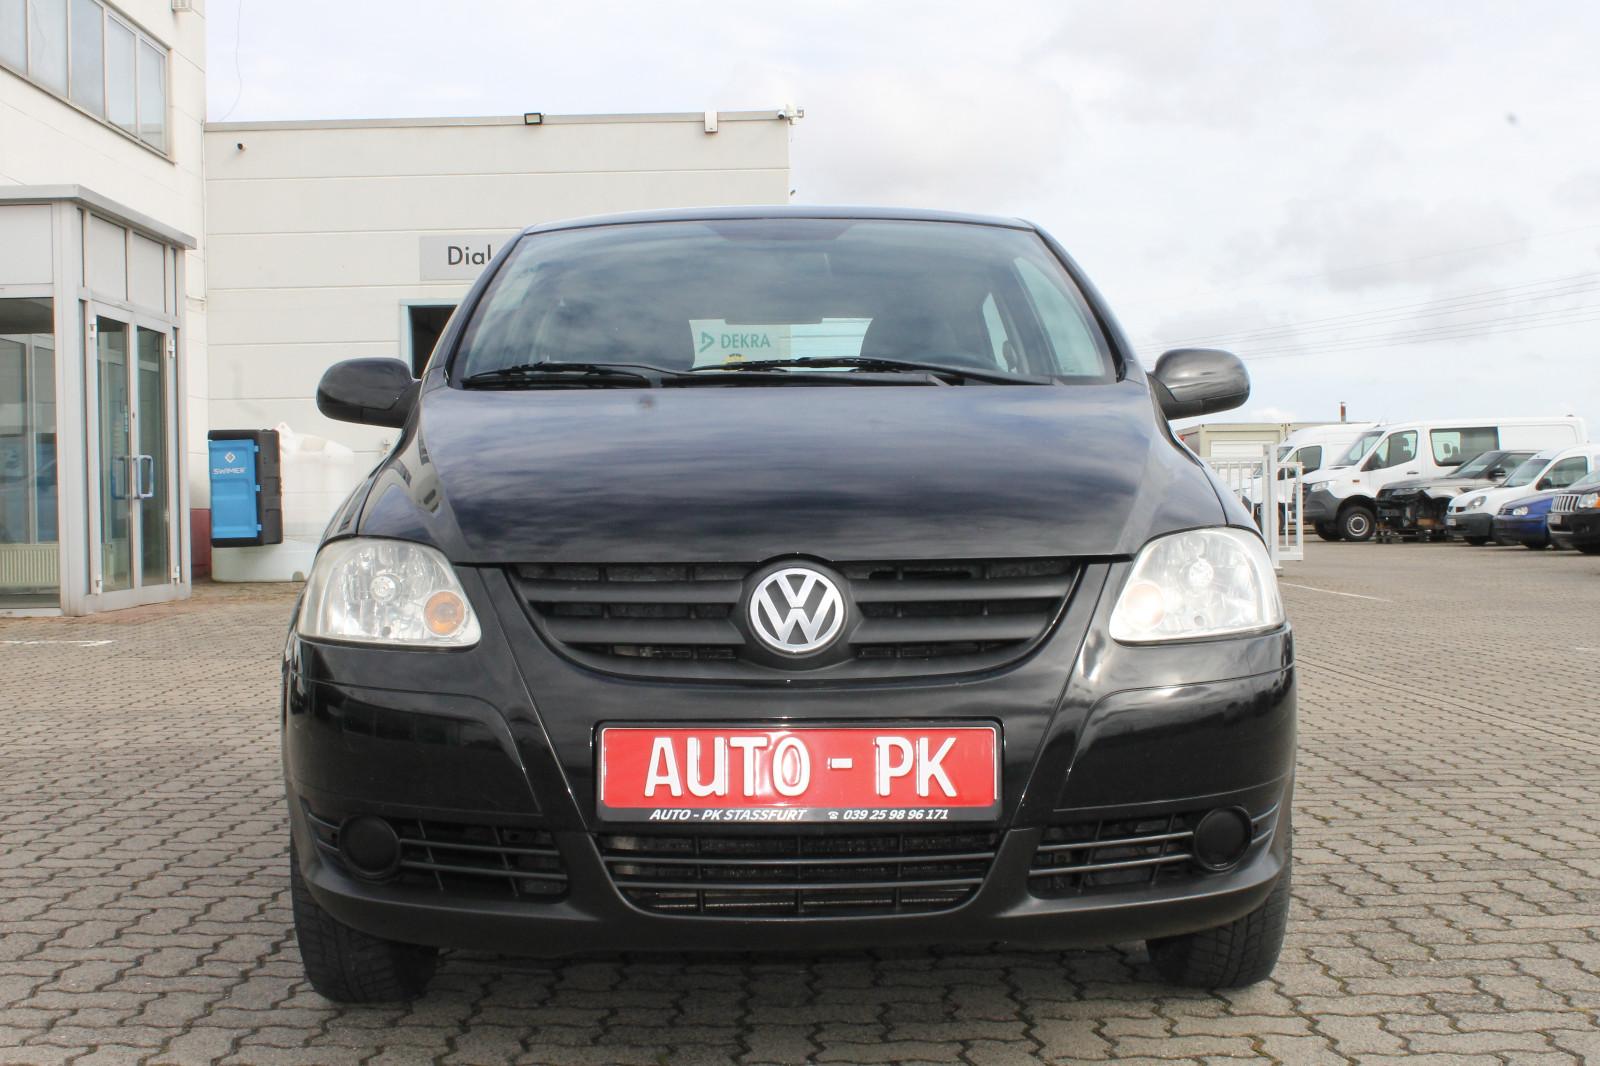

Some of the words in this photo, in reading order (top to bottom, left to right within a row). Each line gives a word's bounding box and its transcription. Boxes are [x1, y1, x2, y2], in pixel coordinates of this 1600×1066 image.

[721, 333, 770, 349] DEKRA
[644, 736, 811, 798] AUTO
[875, 736, 958, 798] PK
[649, 809, 692, 821] AUTO
[701, 809, 722, 821] PK
[723, 809, 808, 821] STASSFURT
[842, 809, 868, 820] 039
[868, 809, 888, 820] 25
[888, 809, 906, 820] 98
[906, 809, 924, 820] 96
[925, 809, 949, 820] 171
